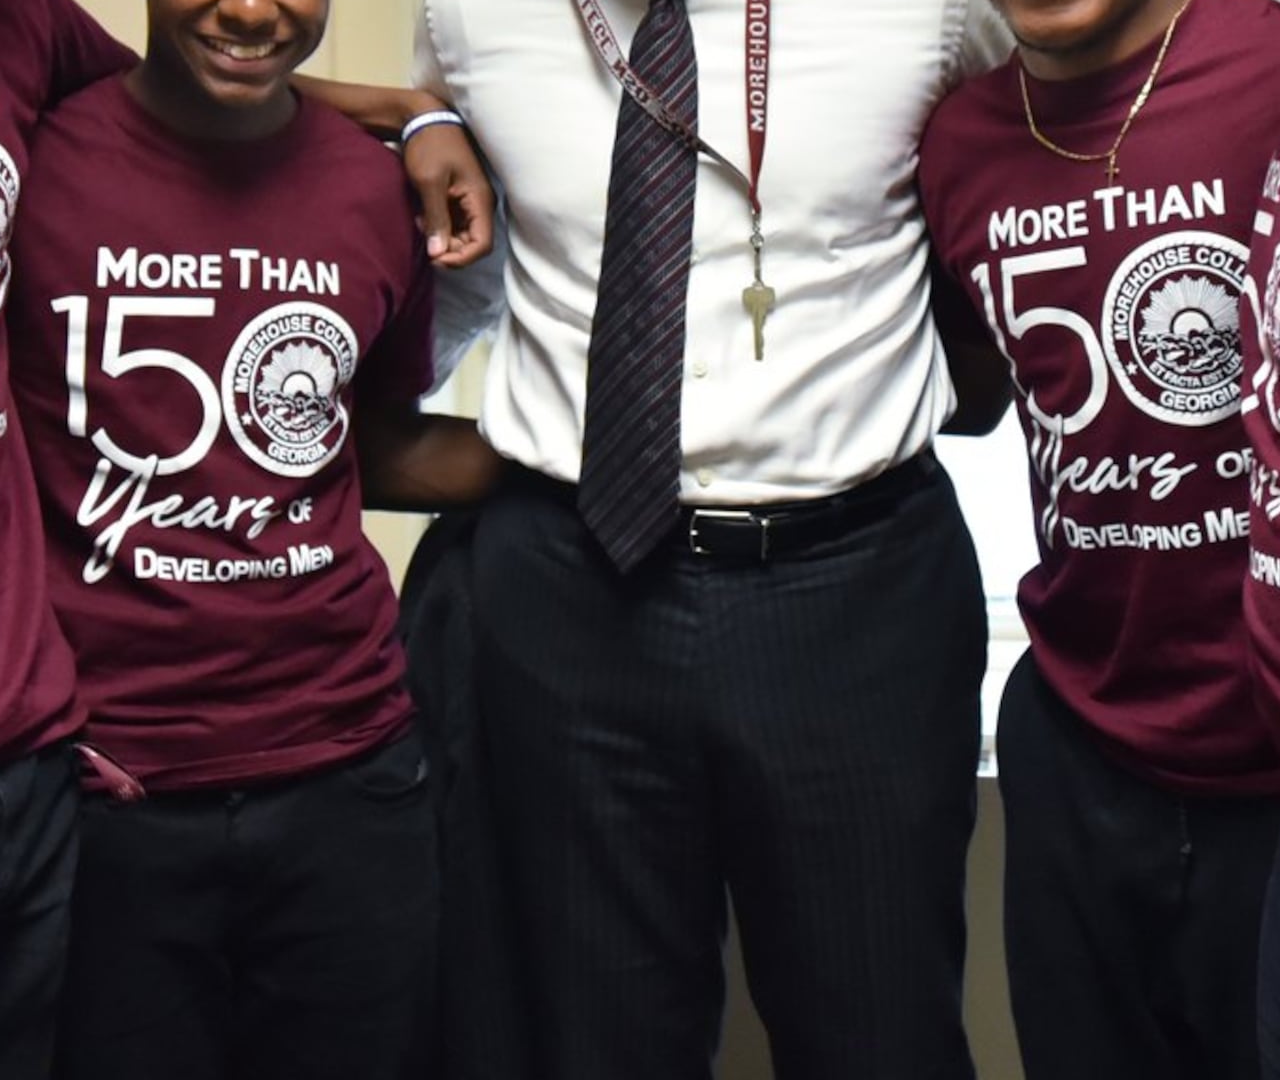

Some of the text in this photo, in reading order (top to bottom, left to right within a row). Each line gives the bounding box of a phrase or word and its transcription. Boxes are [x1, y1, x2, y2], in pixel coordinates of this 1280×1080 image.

[987, 178, 1225, 251] MORE THAN
[96, 246, 341, 296] MORE THAN
[1113, 246, 1247, 341] MOREHOUSE COLL
[234, 315, 312, 393] MOREHOUSE
[1159, 381, 1242, 412] GEORGIA
[1203, 506, 1251, 544] ME
[133, 546, 287, 584] DEVELOPING
